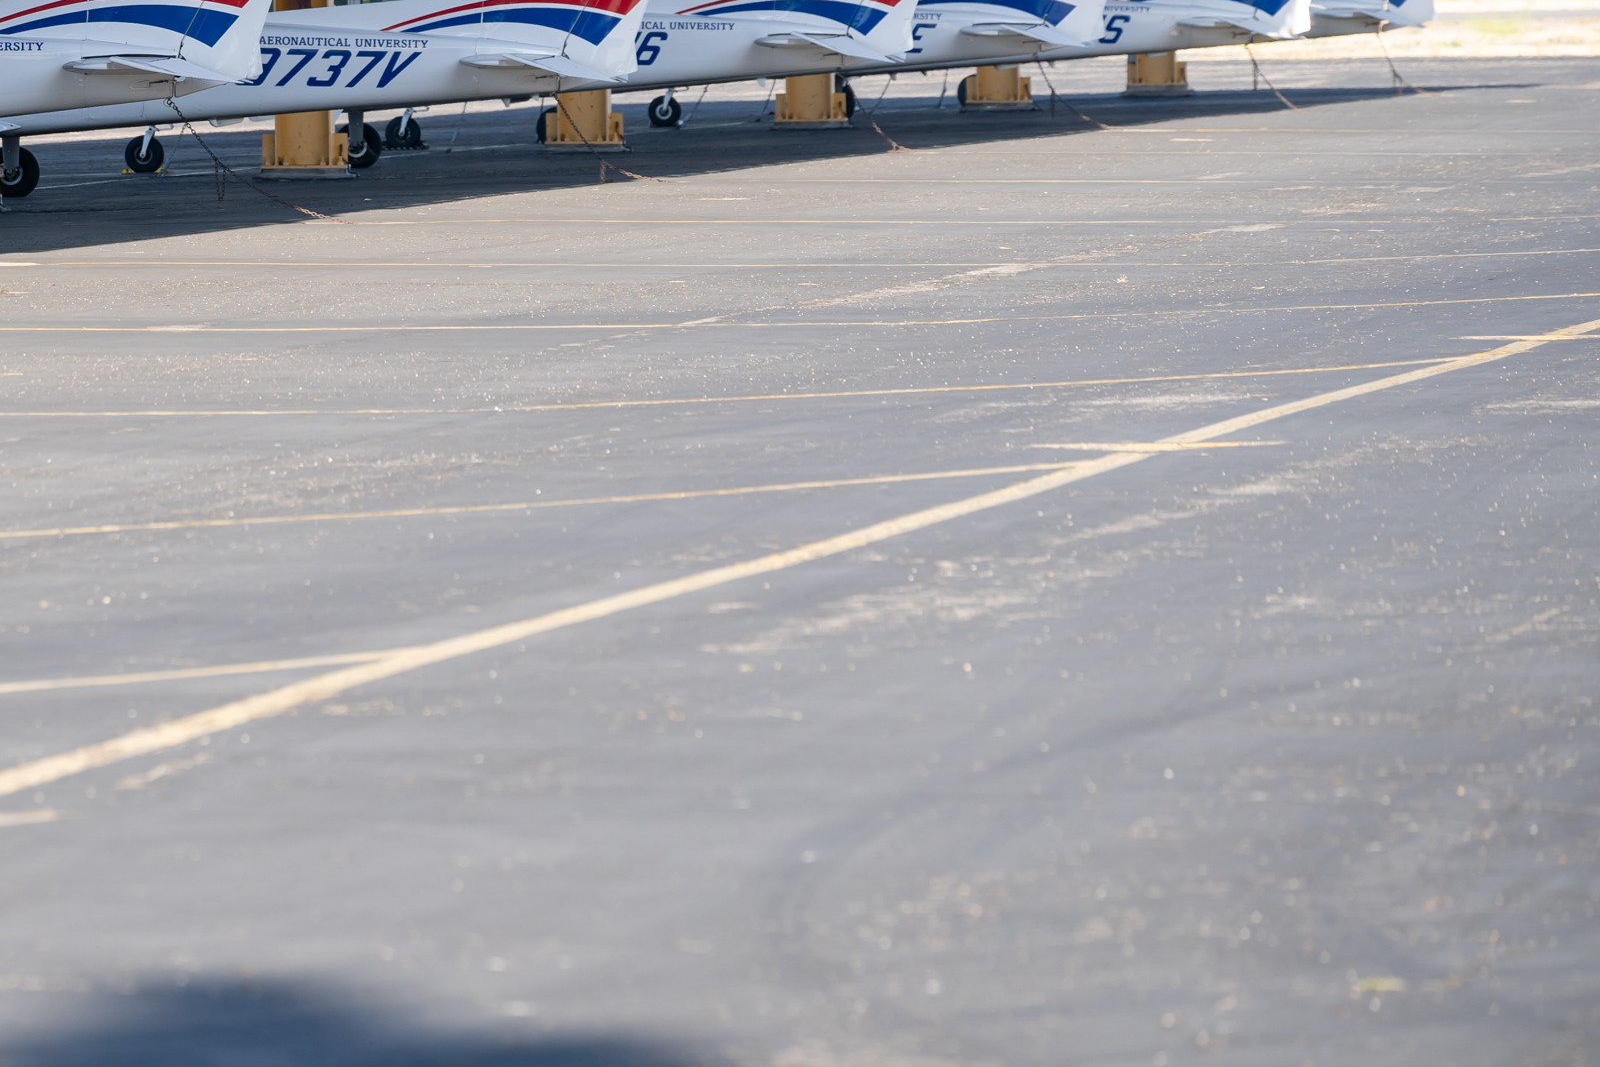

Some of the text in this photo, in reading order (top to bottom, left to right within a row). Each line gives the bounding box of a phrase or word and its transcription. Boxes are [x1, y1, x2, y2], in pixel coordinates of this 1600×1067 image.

[669, 22, 735, 31] UNIVERSITY
[260, 35, 429, 49] AERONAUTICAL UNIVERSITY
